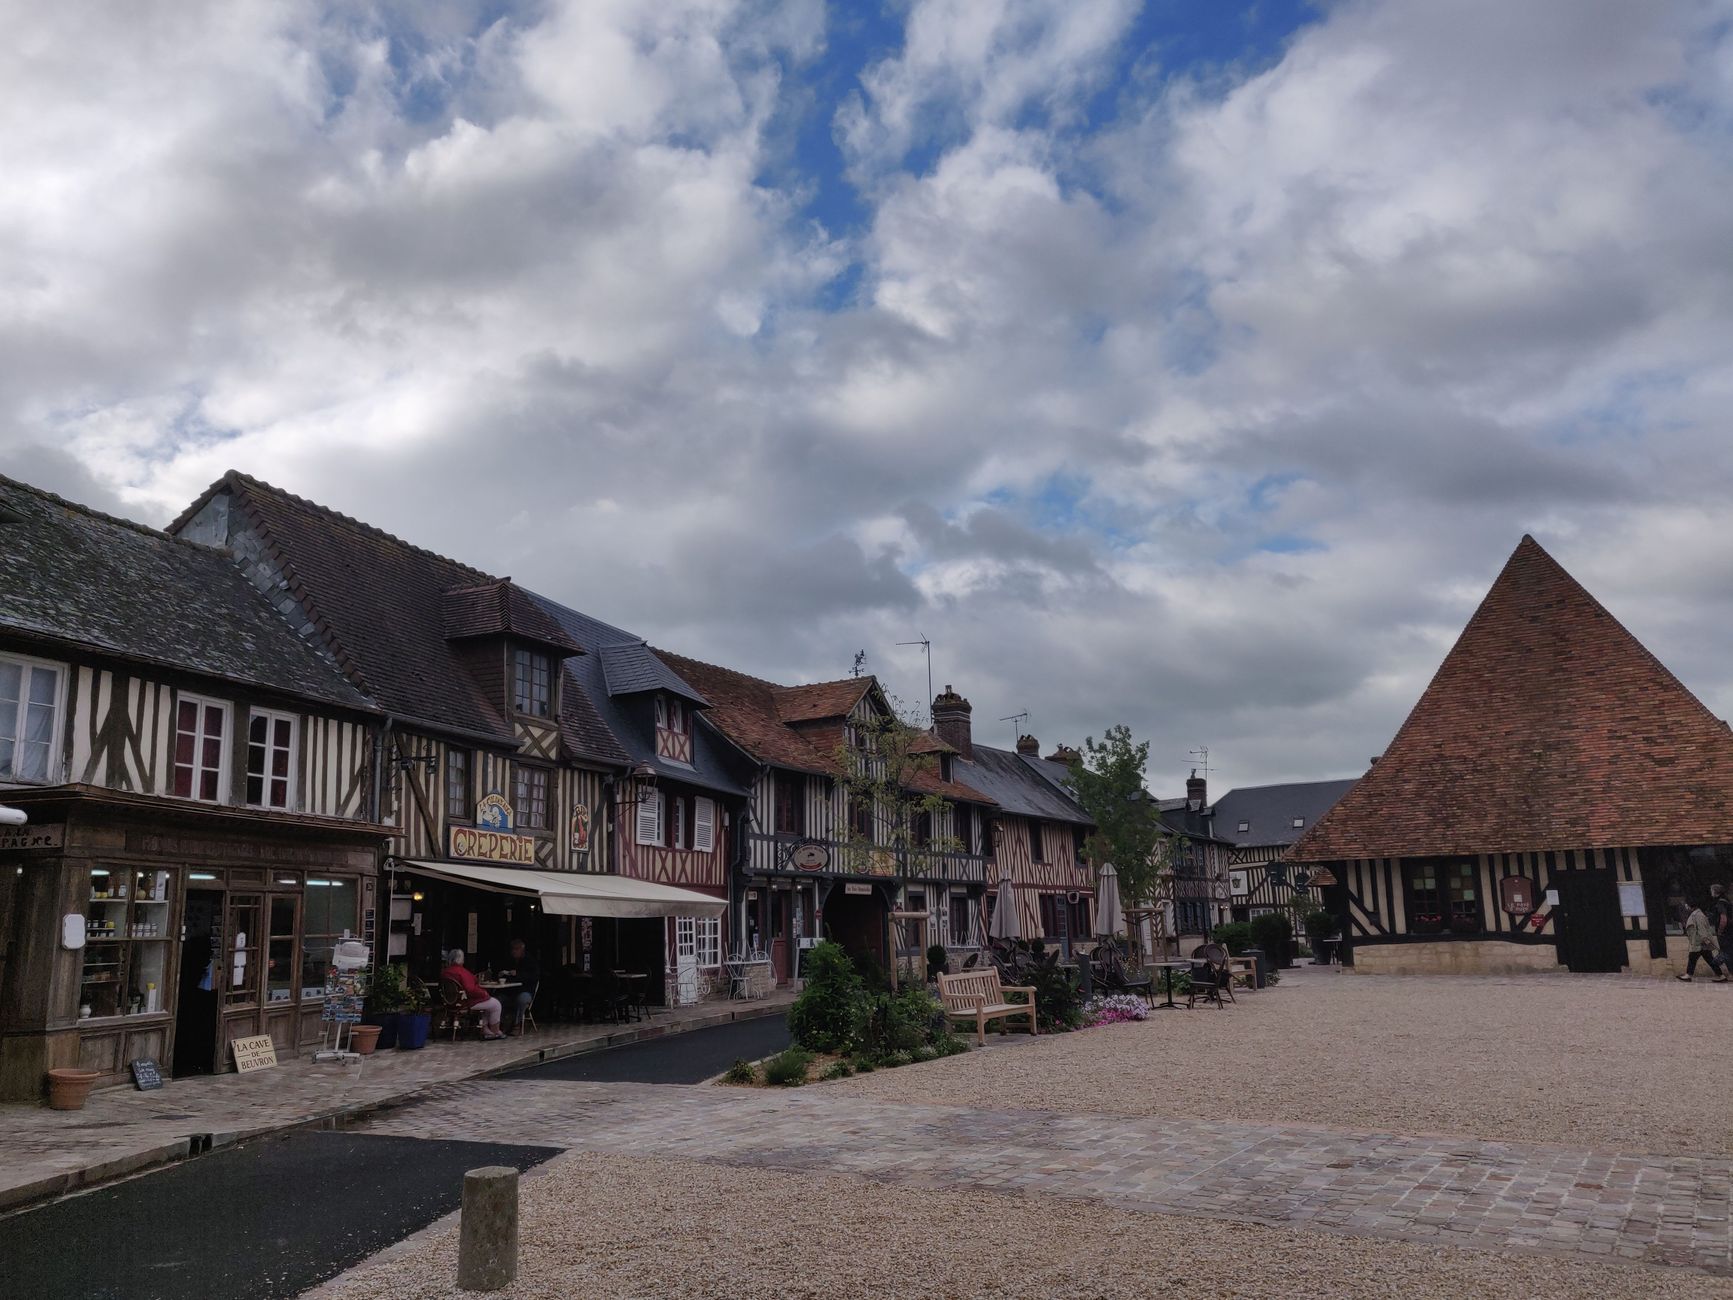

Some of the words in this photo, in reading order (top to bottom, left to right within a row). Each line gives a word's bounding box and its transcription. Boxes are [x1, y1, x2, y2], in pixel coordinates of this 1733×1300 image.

[453, 829, 532, 862] CREPERIE
[237, 1043, 248, 1052] LA
[249, 1039, 270, 1050] CAVE
[251, 1050, 261, 1058] DE
[241, 1056, 274, 1070] BEUVRON
